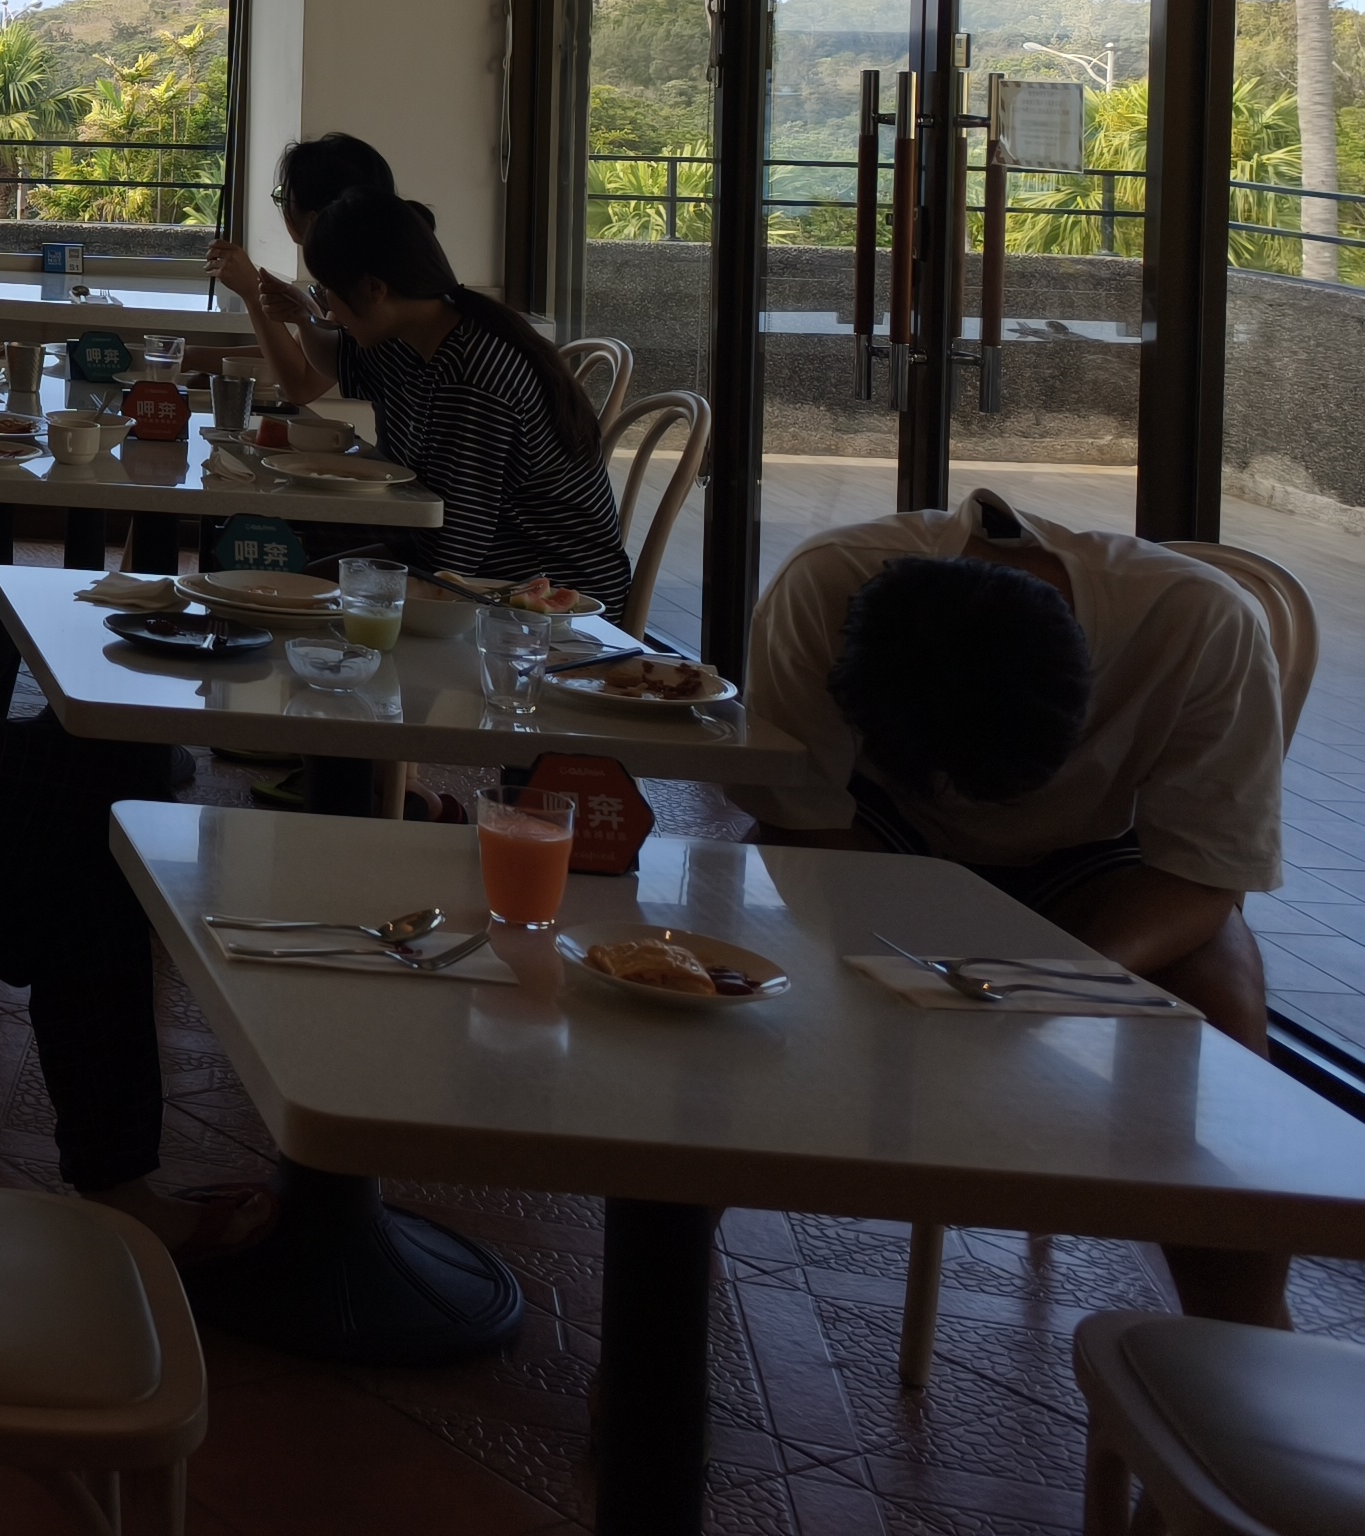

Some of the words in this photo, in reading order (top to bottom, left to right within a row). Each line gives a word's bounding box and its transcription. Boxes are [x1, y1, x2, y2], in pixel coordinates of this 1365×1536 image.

[85, 347, 120, 364] 呷奔
[136, 400, 177, 419] 呷奔
[234, 539, 289, 567] 呷奔
